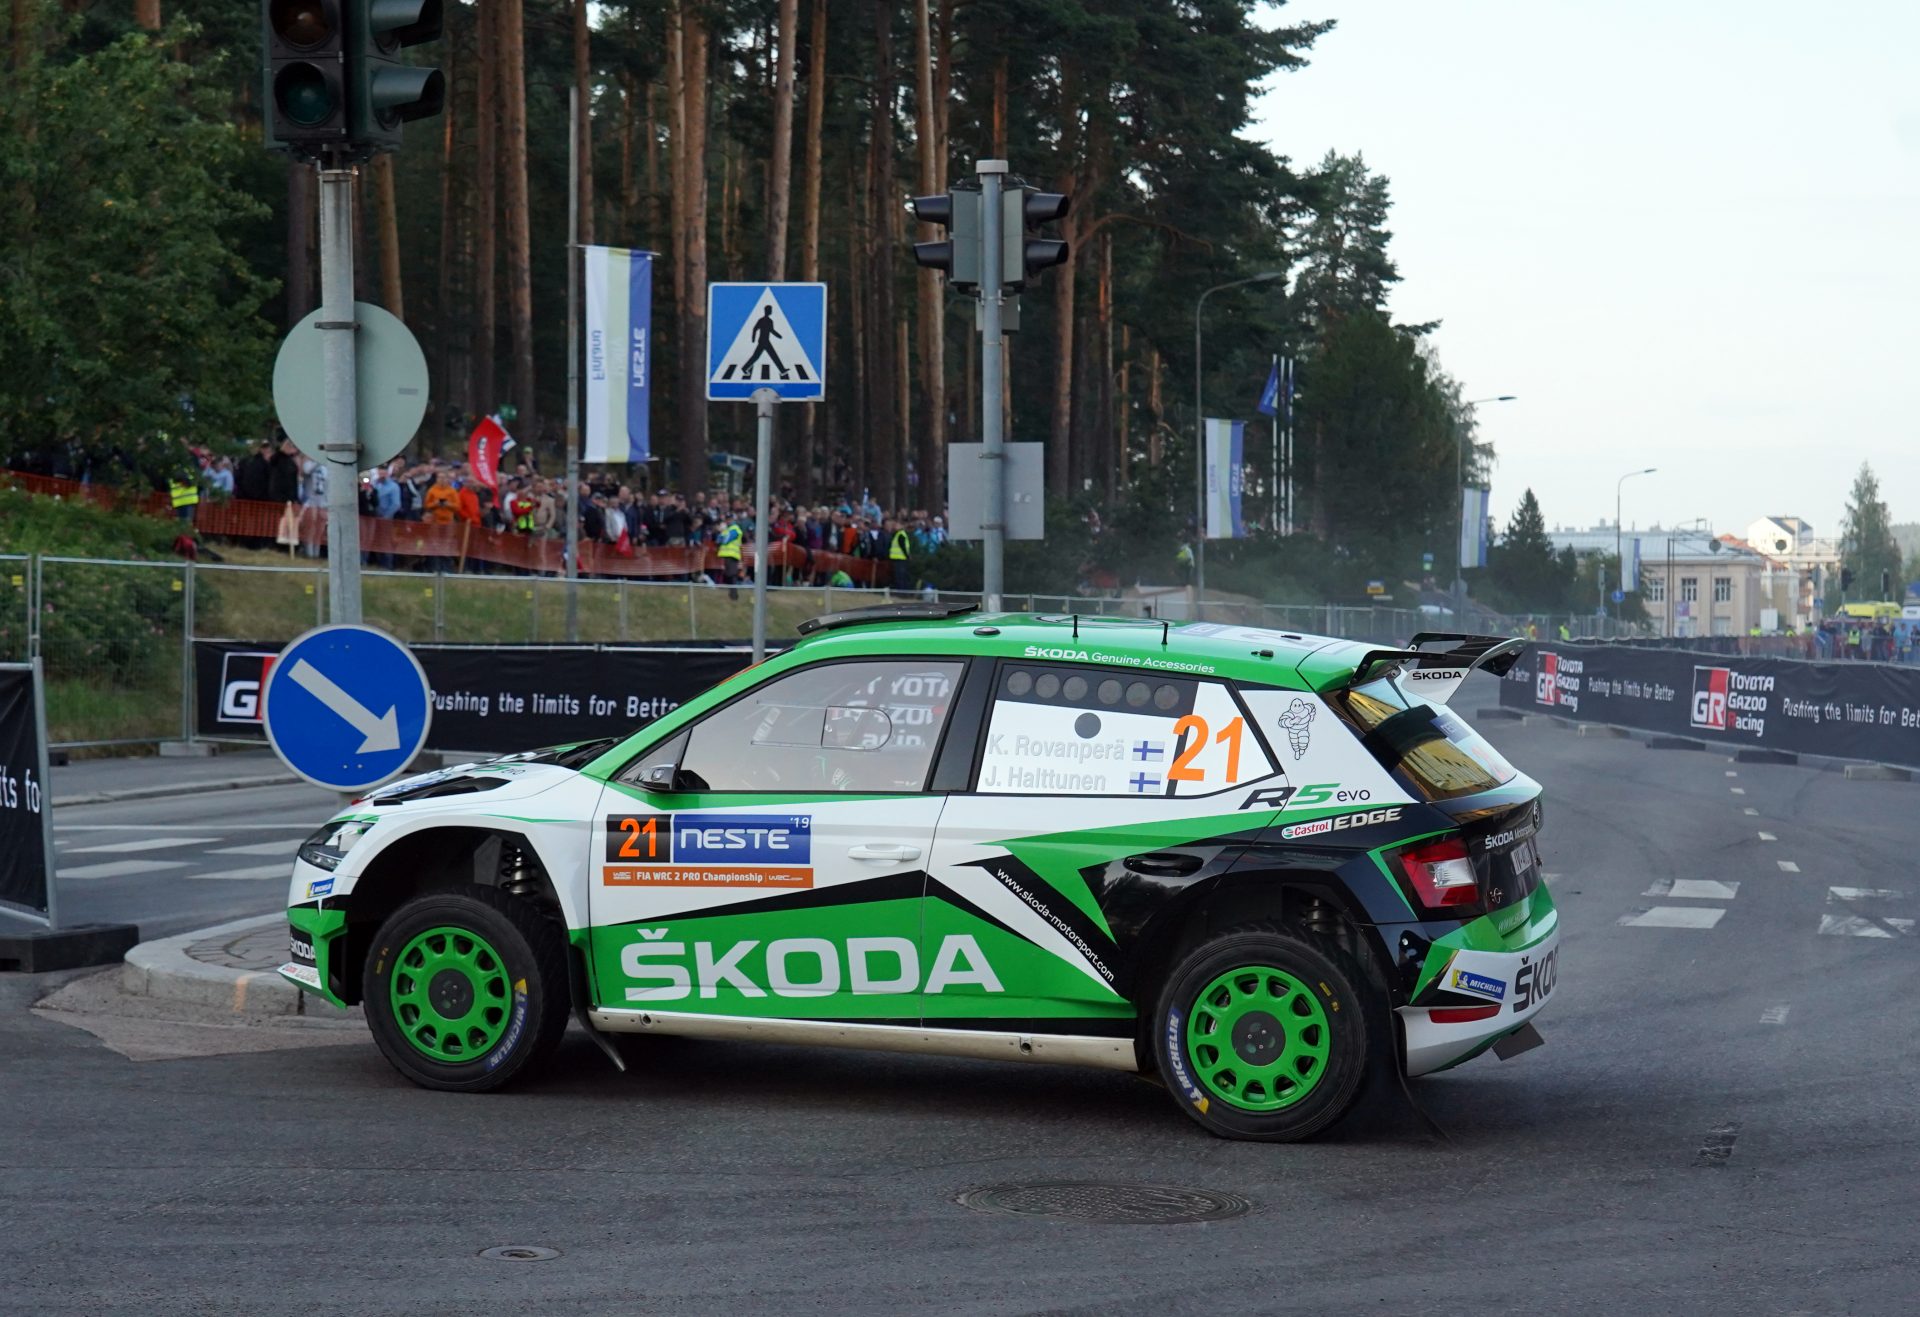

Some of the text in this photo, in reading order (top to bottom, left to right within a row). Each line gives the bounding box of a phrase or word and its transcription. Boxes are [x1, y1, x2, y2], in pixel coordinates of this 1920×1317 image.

[1024, 645, 1216, 674] ŠKODA Genuine Accessories
[1557, 656, 1583, 674] TOYOTA
[1412, 670, 1462, 681] ŠKODA
[1537, 672, 1556, 701] GR
[1556, 673, 1580, 692] GAZOO
[1730, 671, 1775, 692] TOYOTA
[1555, 690, 1578, 712] Racing
[1588, 677, 1675, 702] Pushing the limits for Better
[1728, 692, 1767, 712] GAZOO
[498, 692, 524, 714] the
[532, 693, 580, 715] limits
[589, 694, 617, 716] for
[1693, 690, 1725, 726] GR
[1783, 698, 1820, 724] Pushing
[1825, 702, 1841, 721] the
[1846, 703, 1875, 724] limits
[1879, 705, 1897, 725] for
[1728, 713, 1765, 737] Racing
[989, 734, 1125, 764] K. Rovanperä
[1167, 714, 1244, 783] 21
[984, 766, 1107, 792] J. Halttunen
[1238, 783, 1371, 810] R5 evo
[1294, 807, 1403, 837] Castrol EDGE
[619, 817, 657, 857] 21
[680, 828, 790, 849] NESTE
[1485, 830, 1514, 850] ŠKODA
[637, 872, 651, 881] FIA
[653, 872, 673, 881] WRC
[674, 872, 680, 881] 2
[683, 872, 700, 881] PRO
[703, 872, 763, 883] Championship
[997, 868, 1115, 982] www.skoda-motorsport.com
[620, 928, 1006, 1001] ŠKODA
[1469, 980, 1503, 994] MICHELIN
[1170, 1014, 1194, 1089] MICHELIN
